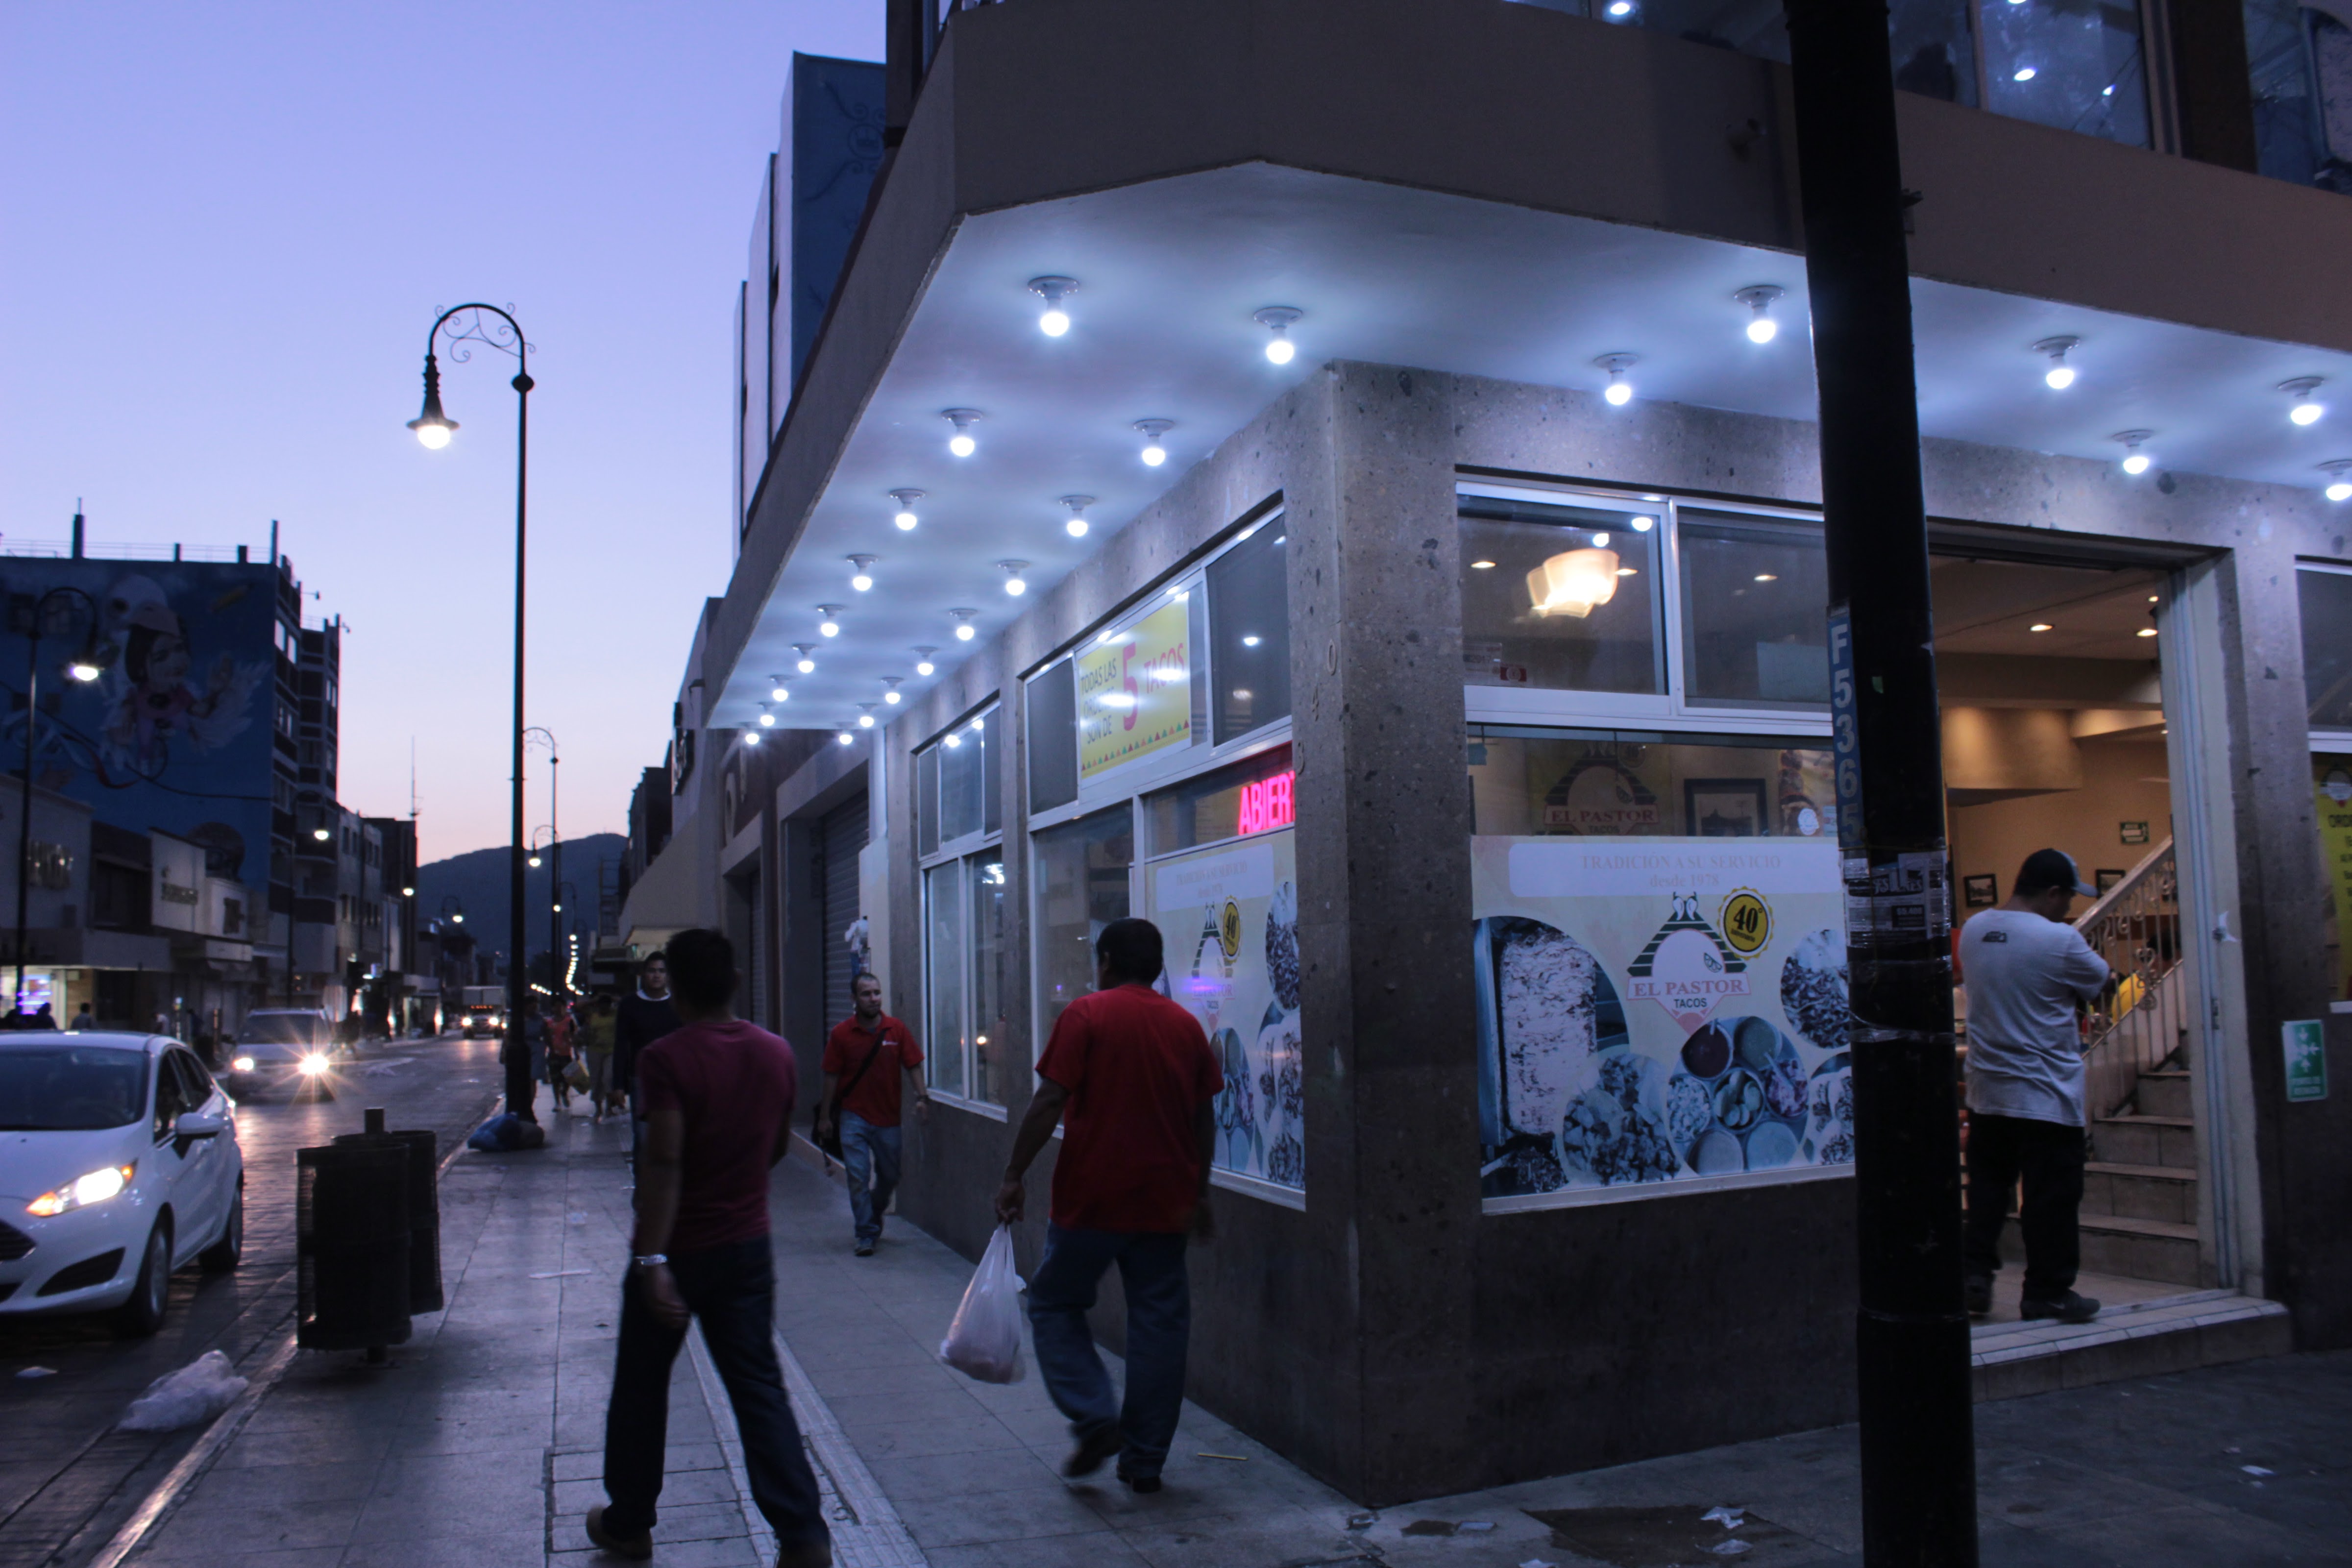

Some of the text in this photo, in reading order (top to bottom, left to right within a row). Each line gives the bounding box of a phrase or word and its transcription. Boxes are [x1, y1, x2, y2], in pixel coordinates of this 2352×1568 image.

[1081, 657, 1117, 695] TODAS LAS
[1123, 641, 1138, 732] 5
[1087, 714, 1113, 744] SON DE
[1831, 624, 1862, 842] F5365
[1551, 809, 1655, 822] EL PASTOR
[1582, 852, 1781, 870] TRADICIÓN A SU SERVICIO
[1650, 874, 1719, 887] desde 1978
[1634, 979, 1744, 997] EL PASTOR
[1674, 998, 1708, 1008] TACOS
